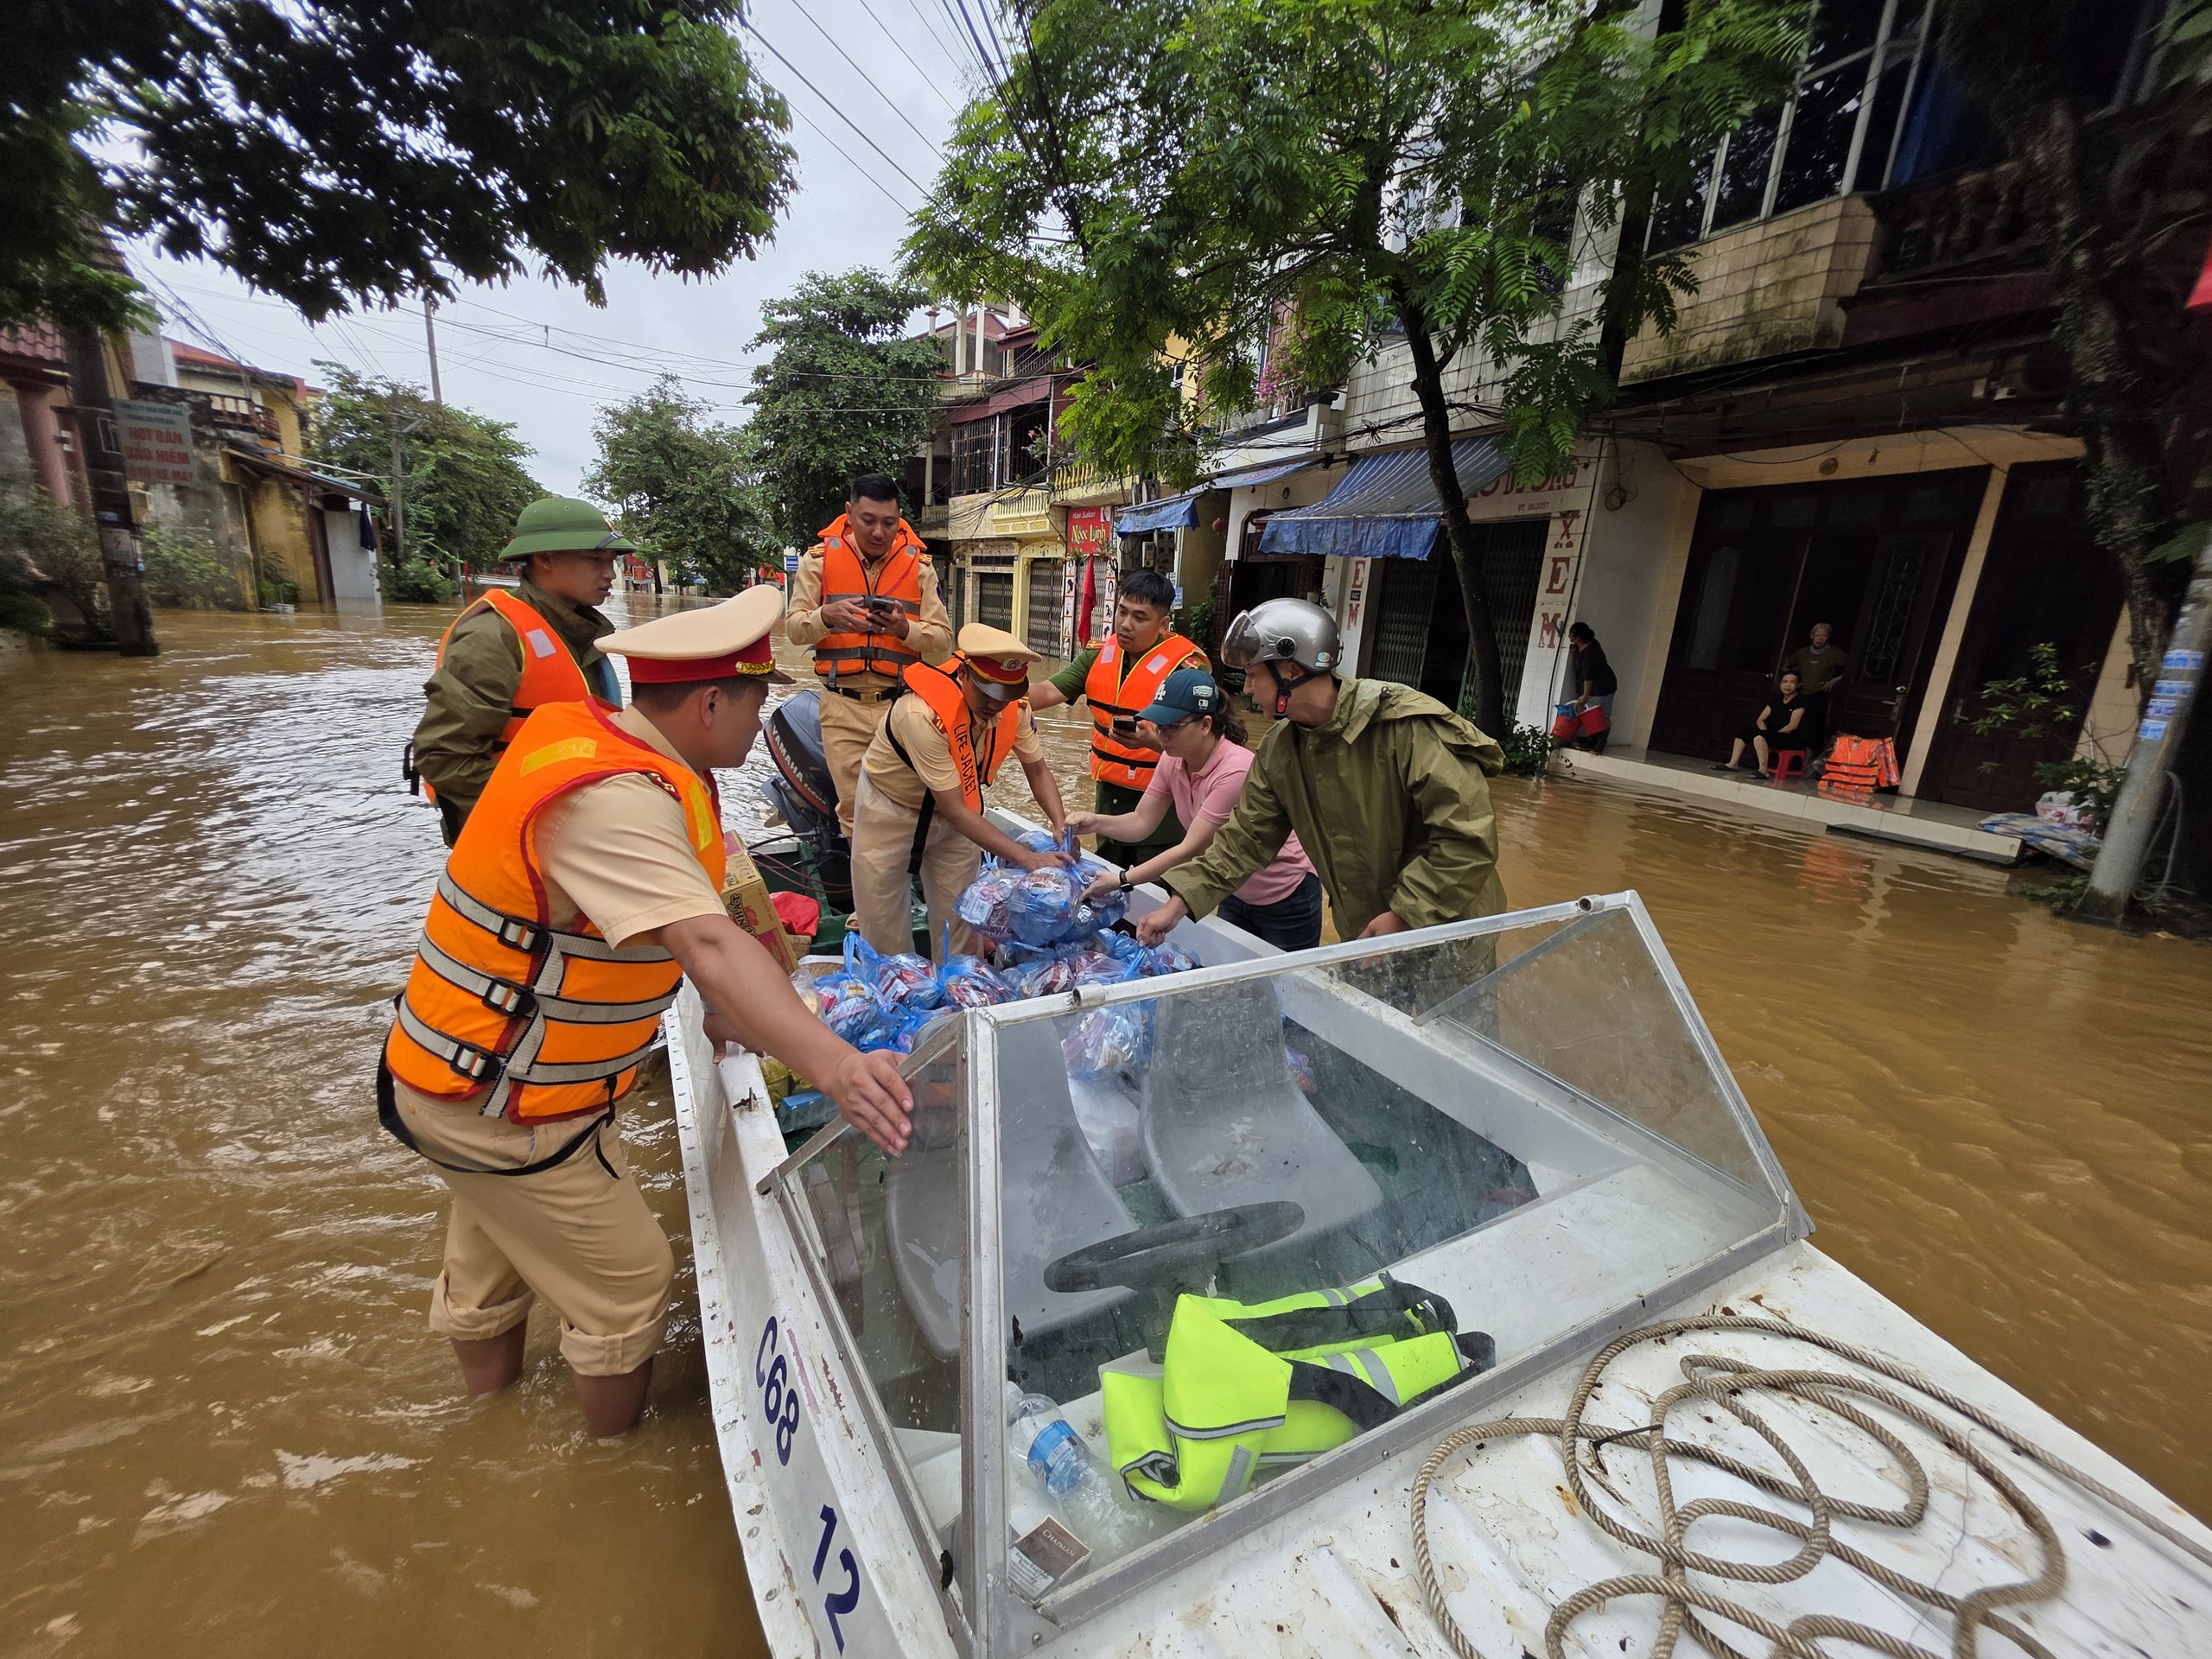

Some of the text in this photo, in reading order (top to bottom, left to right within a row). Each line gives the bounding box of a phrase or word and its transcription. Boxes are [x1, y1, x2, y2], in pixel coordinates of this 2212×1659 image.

[772, 724, 804, 783] YAMAHA
[953, 723, 976, 797] LIFE JACKET
[756, 1315, 800, 1466] C68
[812, 1503, 861, 1657] 12
